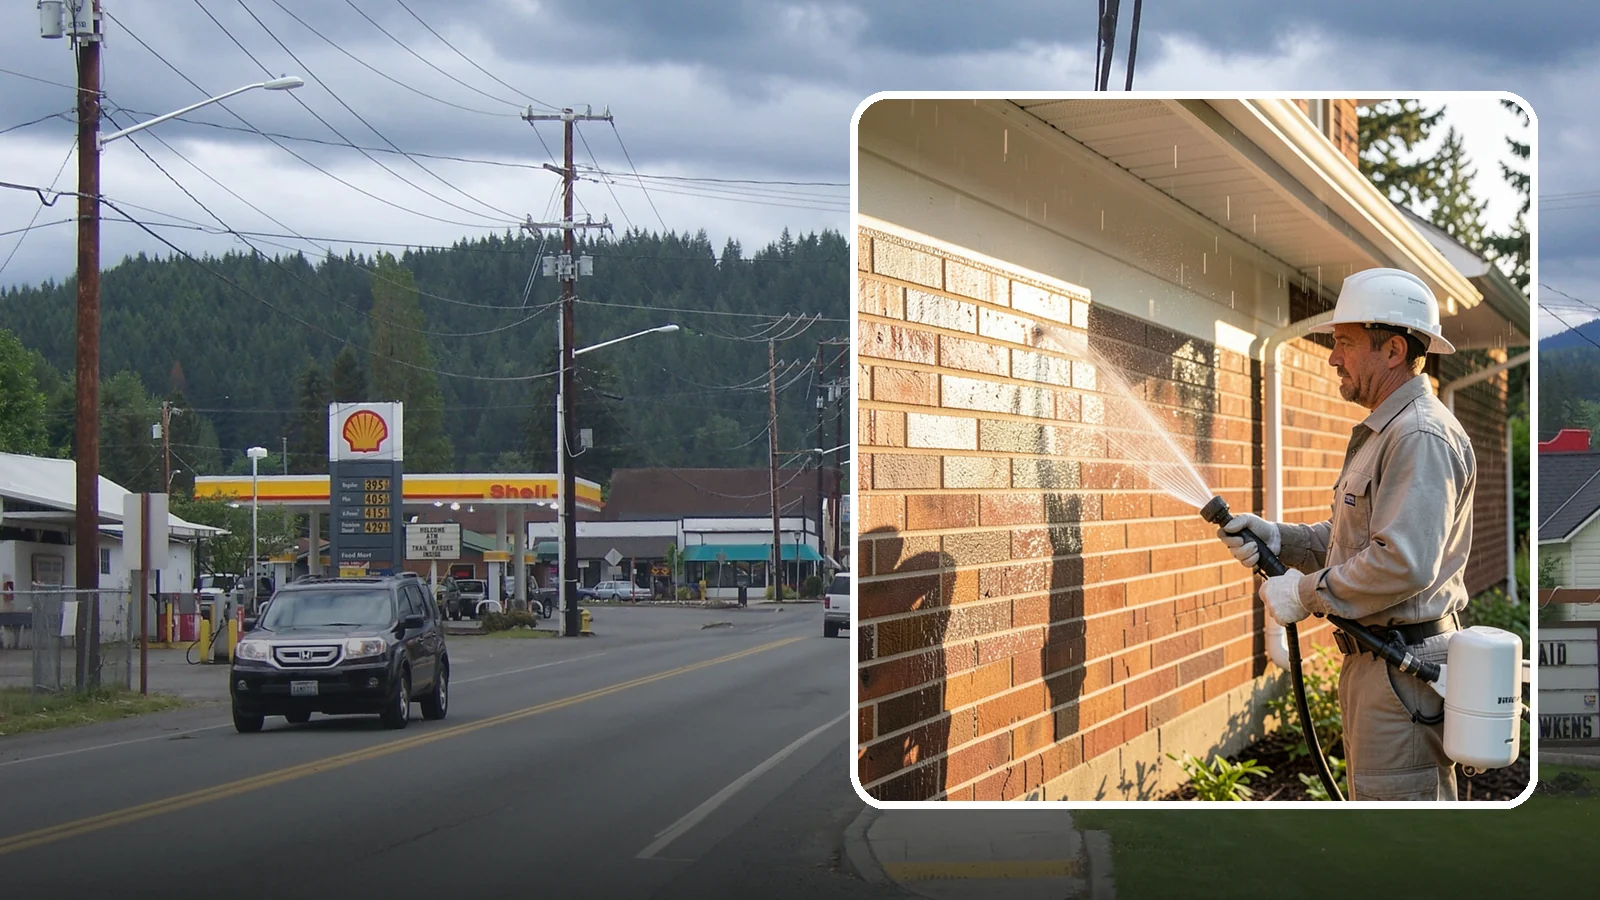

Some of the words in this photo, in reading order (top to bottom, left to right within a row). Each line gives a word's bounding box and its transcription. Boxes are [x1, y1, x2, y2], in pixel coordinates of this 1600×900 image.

[366, 480, 384, 490] 395
[490, 484, 547, 499] Shell
[365, 494, 384, 504] 405
[365, 508, 384, 518] 415
[365, 522, 384, 532] 429
[1538, 643, 1566, 665] AID
[1538, 716, 1592, 739] WKENS
